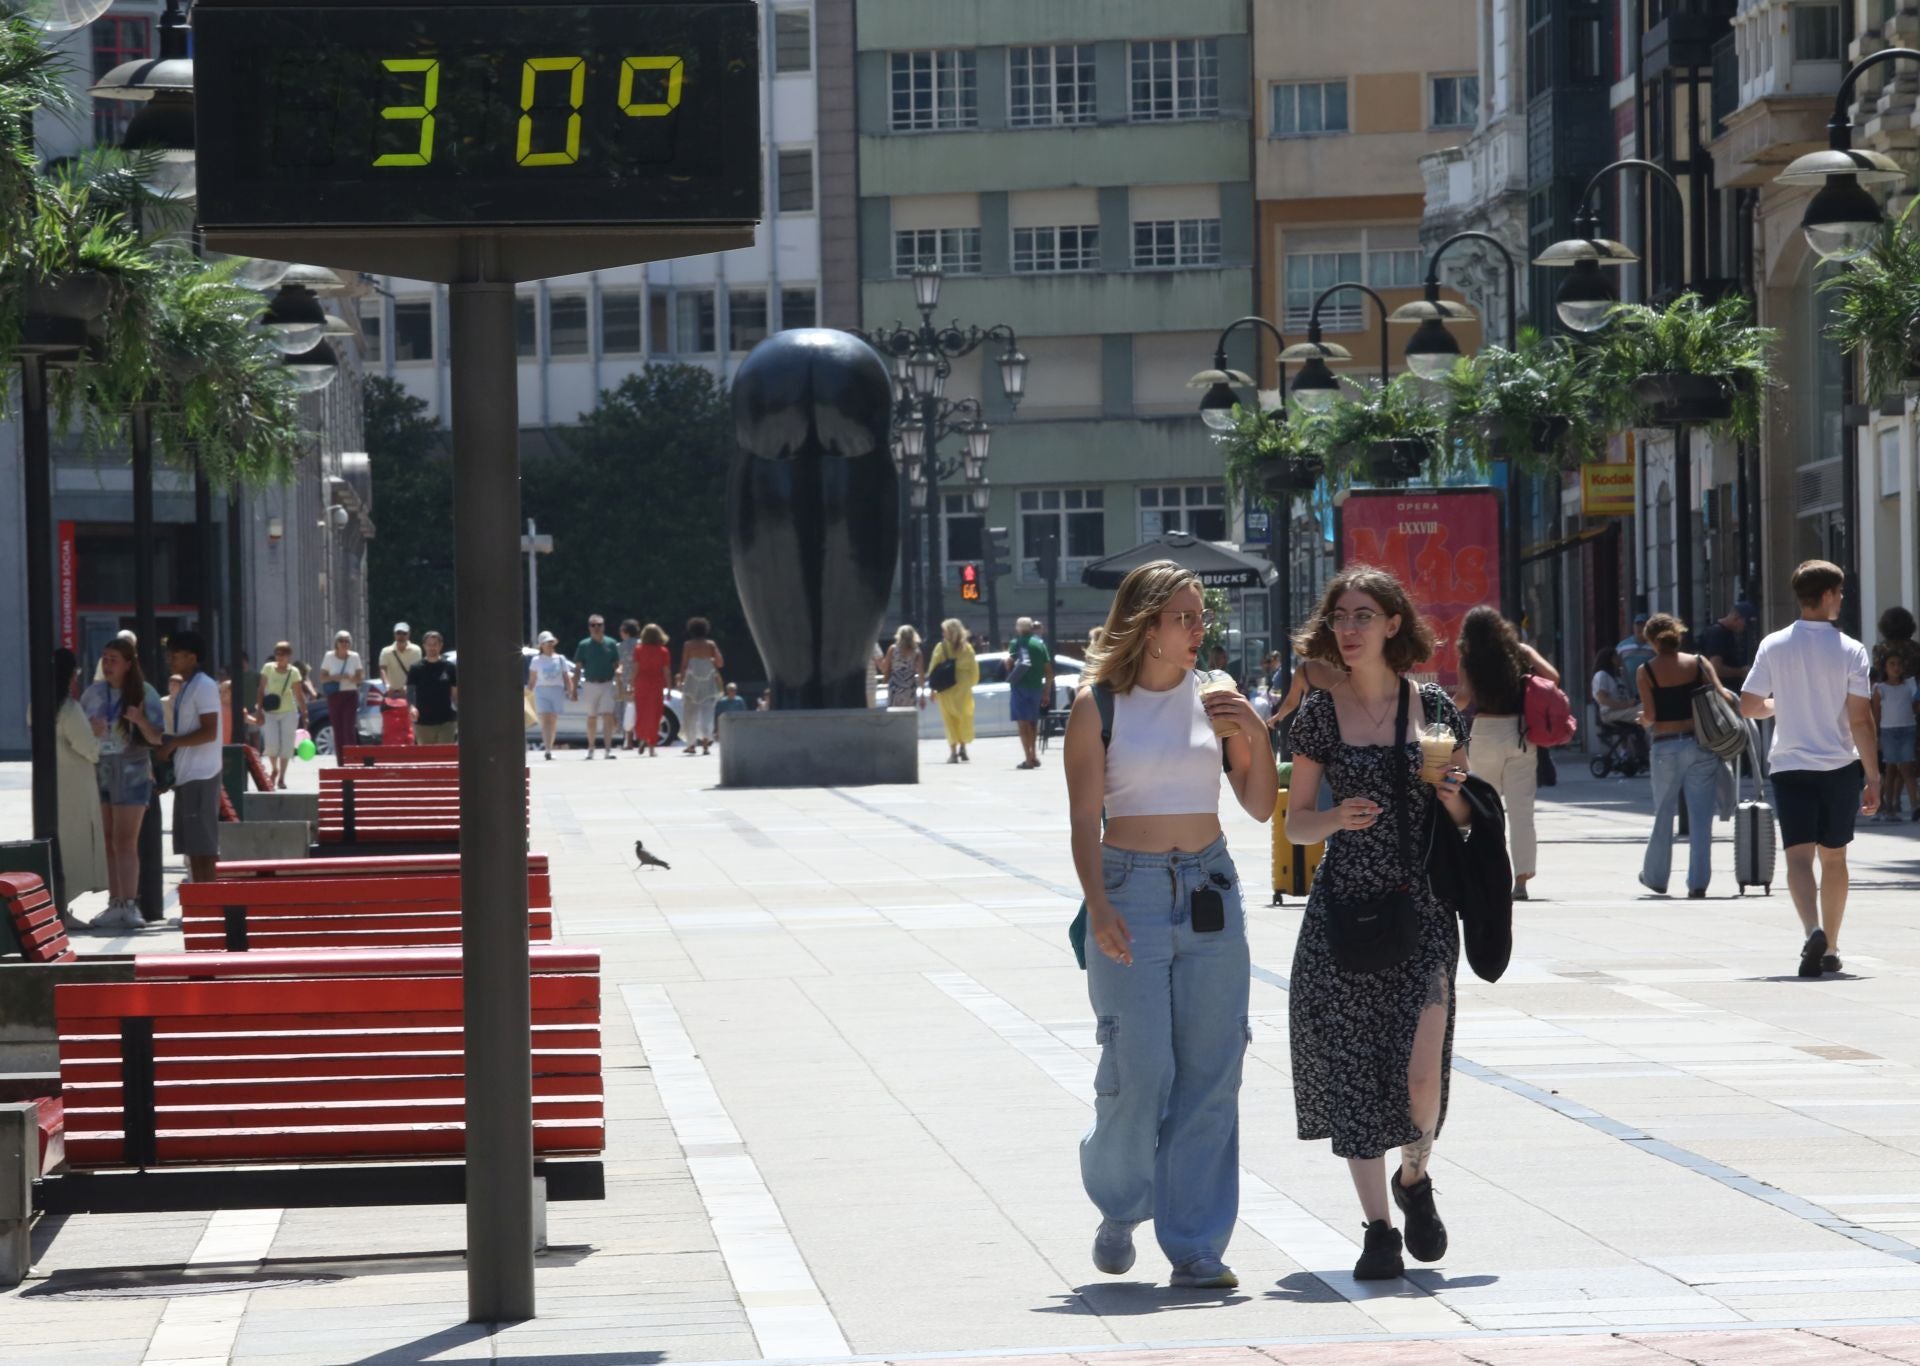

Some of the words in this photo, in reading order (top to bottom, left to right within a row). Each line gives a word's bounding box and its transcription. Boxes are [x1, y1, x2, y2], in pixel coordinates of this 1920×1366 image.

[1592, 473, 1633, 485] Kodak
[1398, 521, 1438, 535] LXXVIII
[62, 540, 71, 576] SOCIAL
[1200, 573, 1248, 585] BUCKS
[63, 578, 72, 634] SEGURIDAD
